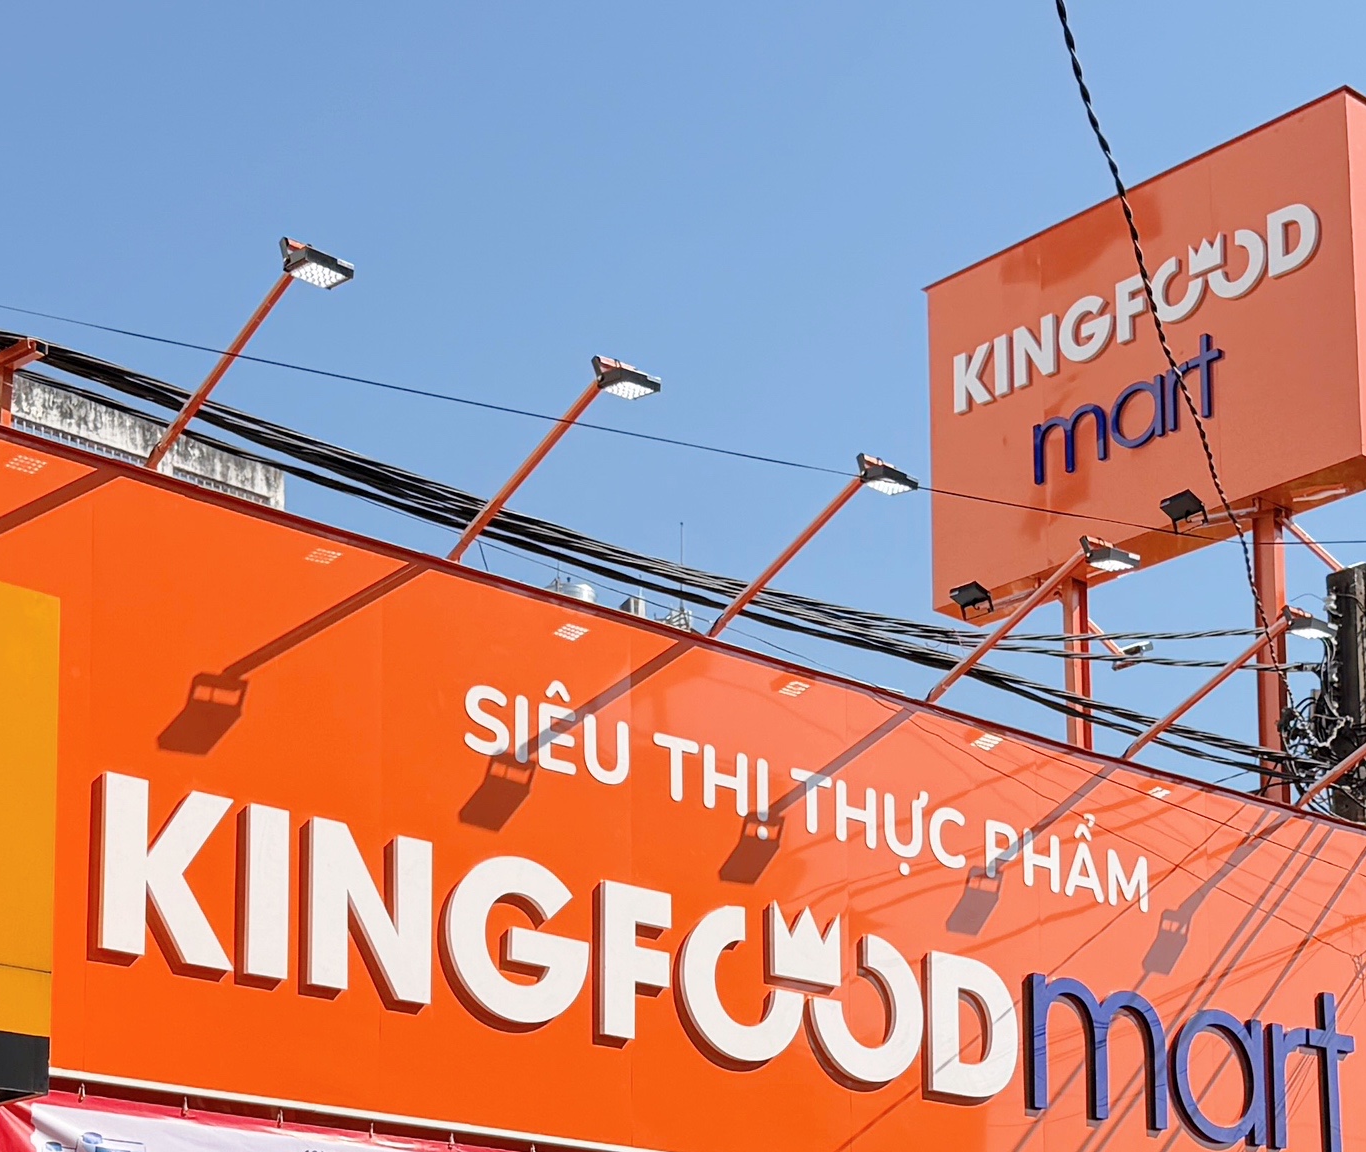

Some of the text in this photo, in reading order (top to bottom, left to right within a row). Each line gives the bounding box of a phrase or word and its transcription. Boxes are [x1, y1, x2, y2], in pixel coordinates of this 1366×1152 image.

[953, 204, 1320, 414] KINGFOOD
[1033, 334, 1224, 485] mart
[464, 681, 1149, 913] SIÊU THỊ THỰC PHẨM
